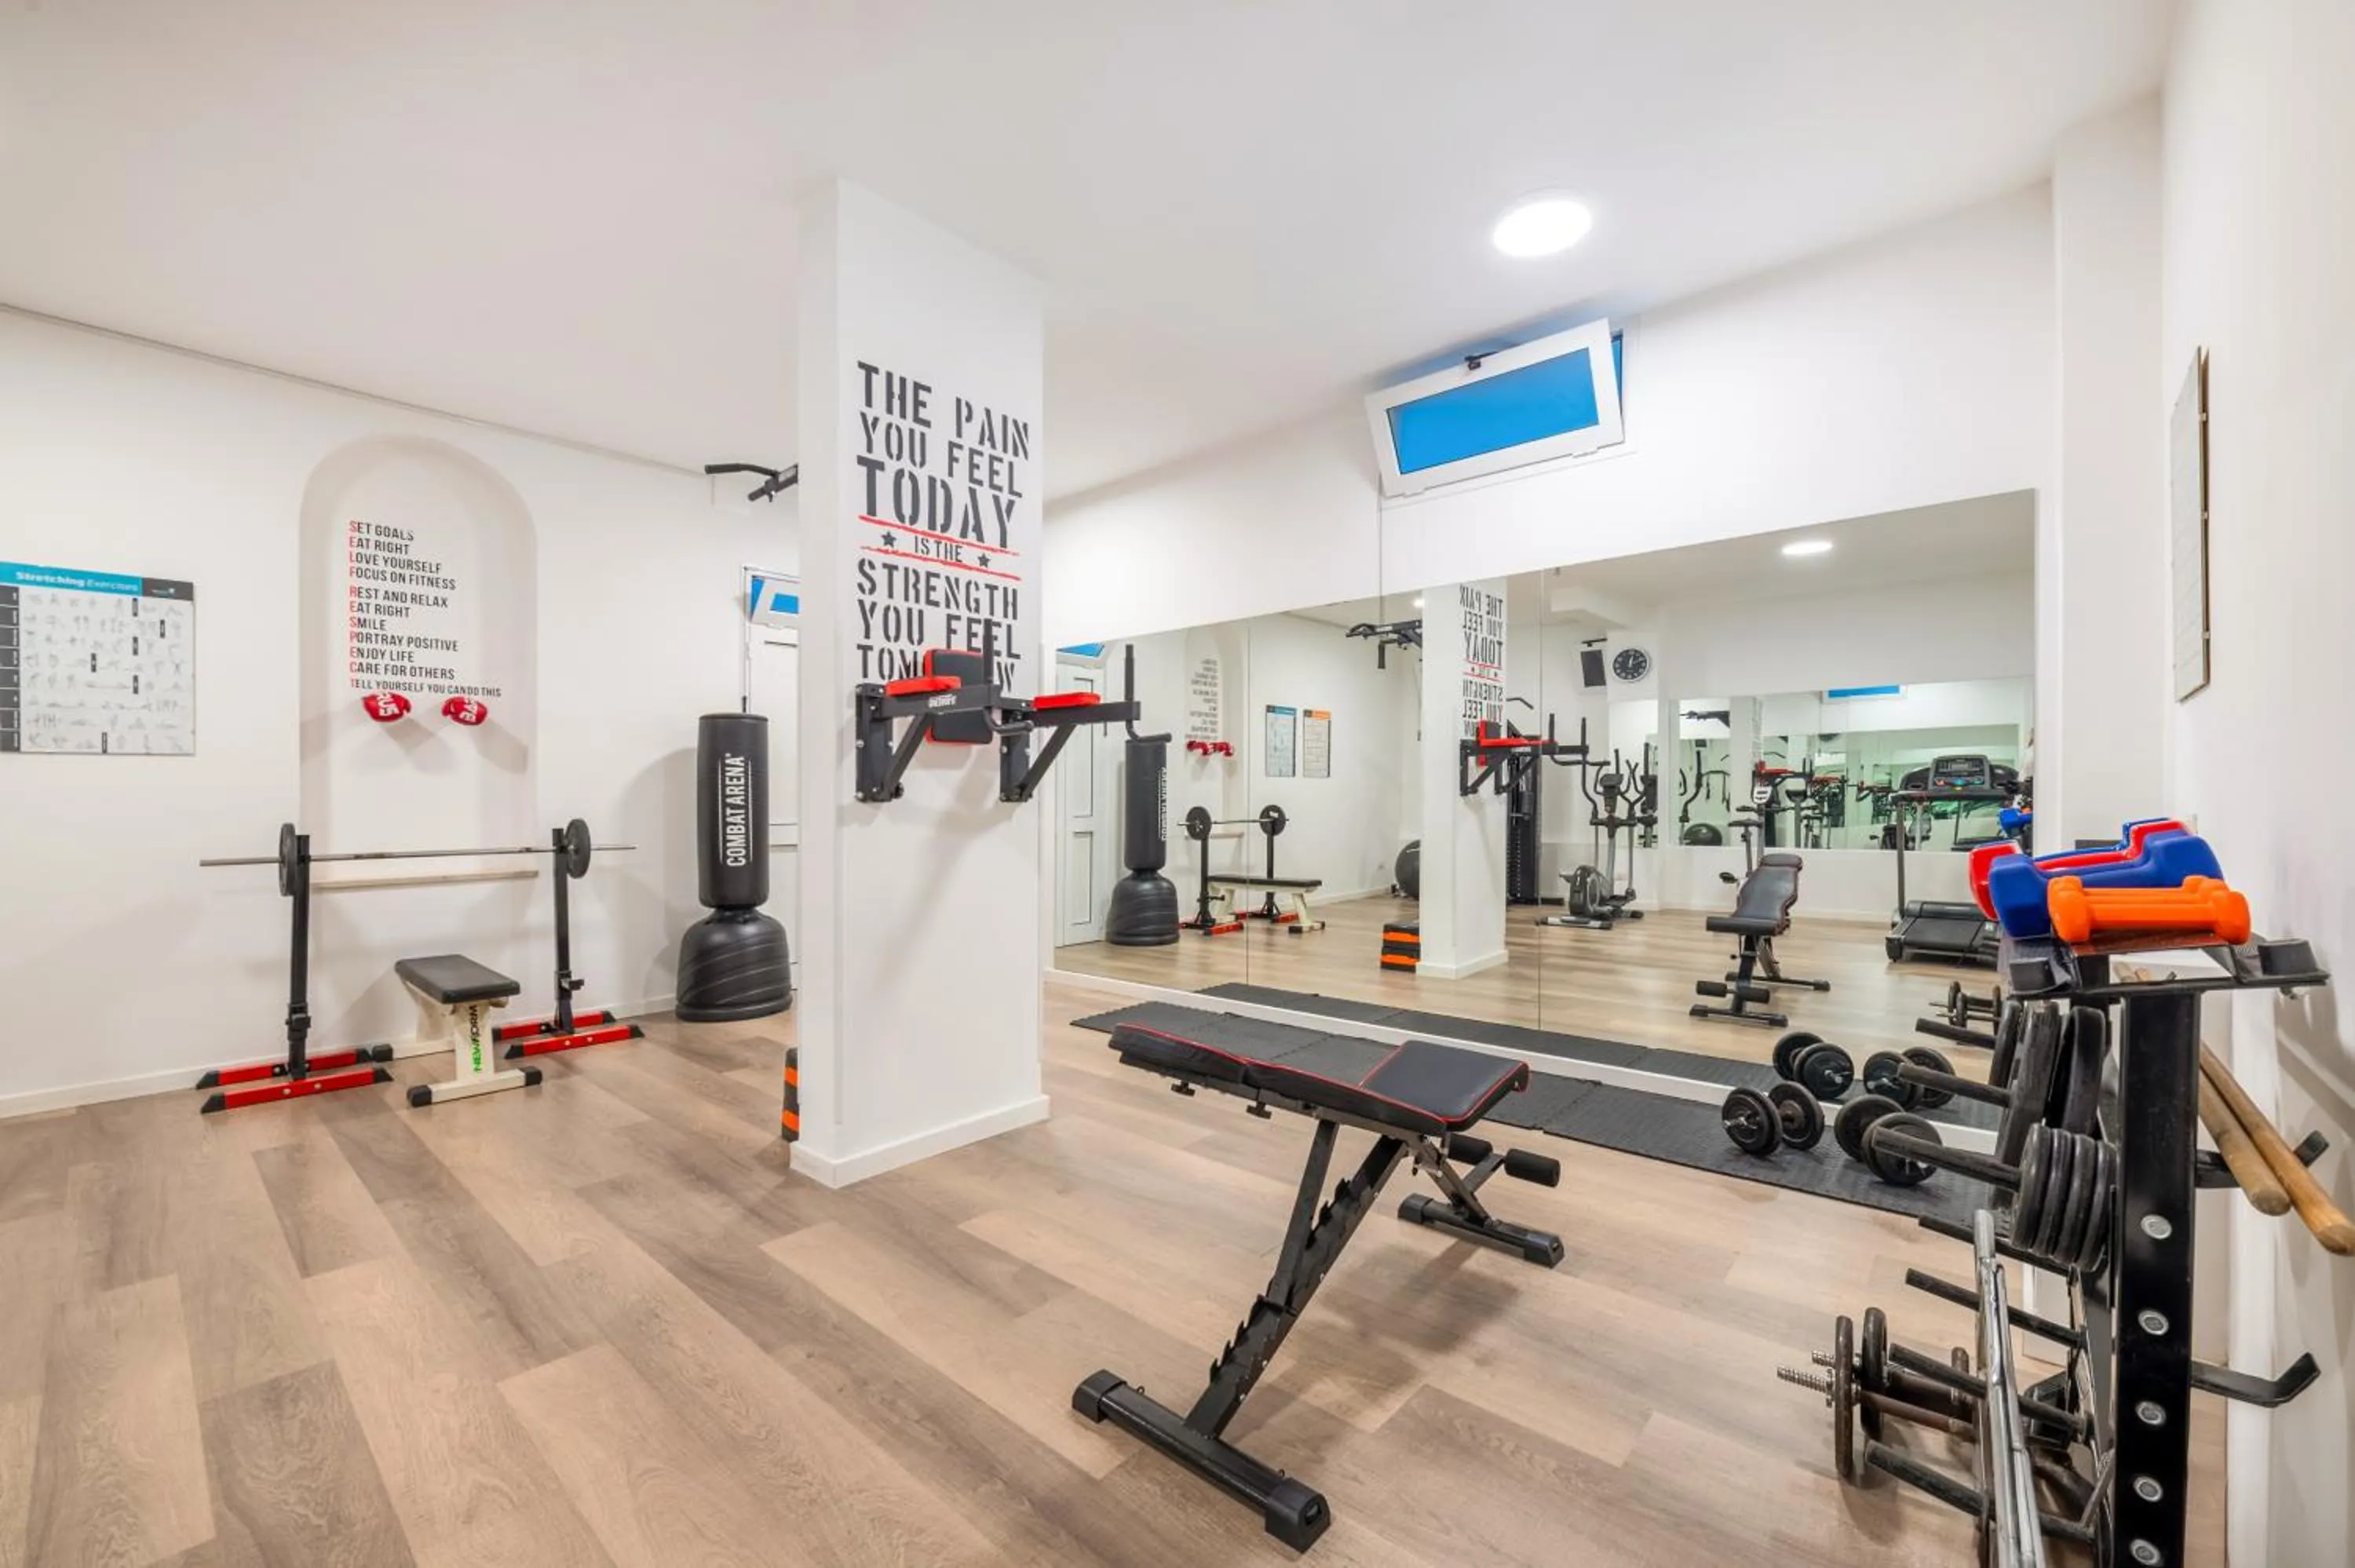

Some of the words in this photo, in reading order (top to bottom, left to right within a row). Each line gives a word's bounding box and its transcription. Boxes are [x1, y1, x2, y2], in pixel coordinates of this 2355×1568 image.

[857, 359, 932, 429] THE
[955, 396, 1029, 461] PAIN
[860, 410, 926, 469] YOU
[947, 440, 1023, 498] FEEL
[856, 454, 1015, 549] TODAY
[349, 520, 371, 534] SET
[374, 525, 414, 542] GOALS
[349, 536, 371, 549] EAT
[374, 539, 410, 556] RIGHT
[915, 535, 929, 556] IS
[934, 540, 964, 563] THE
[349, 552, 380, 566] LOVE
[382, 556, 443, 574] YOURSELF
[16, 571, 85, 588] Stretching
[349, 566, 387, 582] FOCUS
[390, 571, 406, 584] ON
[409, 574, 457, 591] FITNESS
[857, 558, 1017, 620] STRENGTH
[349, 585, 379, 600] REST
[383, 589, 407, 603] AND
[411, 592, 449, 608] RELAX
[349, 600, 371, 614] EAT
[374, 603, 411, 618] RIGHT
[349, 616, 386, 631] SMILE
[857, 599, 924, 646] YOU
[947, 614, 1021, 660] FEEL
[349, 630, 404, 646] PORTRAY
[407, 636, 458, 652] POSITIVE
[349, 646, 387, 661] ENJOY
[389, 651, 415, 663] LIFE
[349, 662, 383, 676] CARE
[384, 665, 407, 676] FOR
[409, 667, 455, 680] OTHERS
[351, 677, 373, 689] TELL
[375, 680, 425, 692] YOURSELF
[427, 684, 445, 695] YOU
[481, 687, 502, 698] THIS
[725, 806, 747, 867] COMBAT
